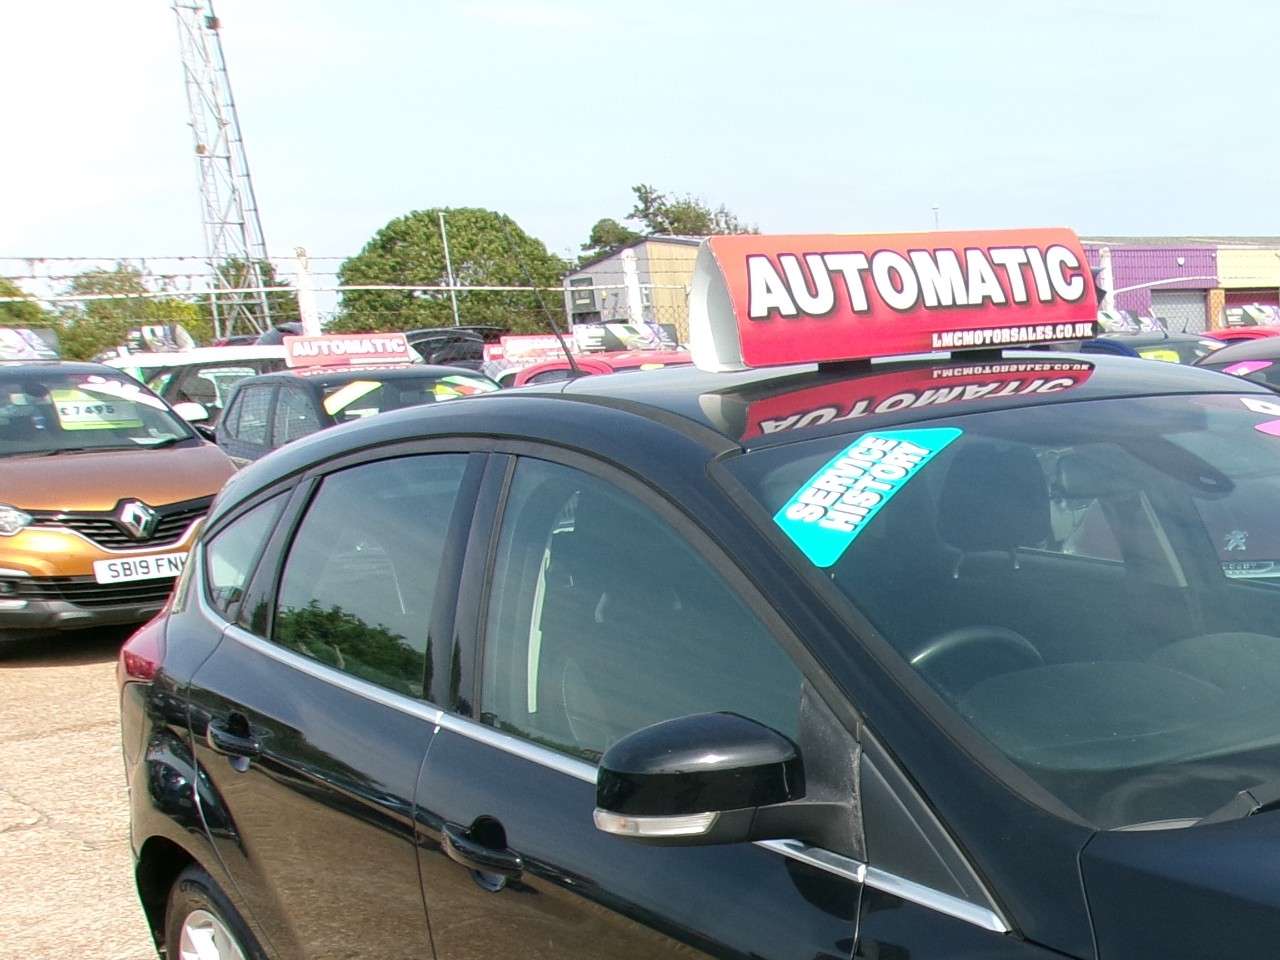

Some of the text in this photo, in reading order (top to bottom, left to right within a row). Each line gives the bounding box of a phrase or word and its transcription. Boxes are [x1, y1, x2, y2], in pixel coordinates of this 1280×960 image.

[747, 244, 1085, 320] AUTOMATIC
[292, 339, 406, 357] AUTOMATIC
[932, 323, 1093, 348] LMCMOTORSALES.CO.UK
[785, 437, 899, 522] SERVICE
[819, 441, 932, 533] HISTORY
[108, 560, 150, 578] SB19
